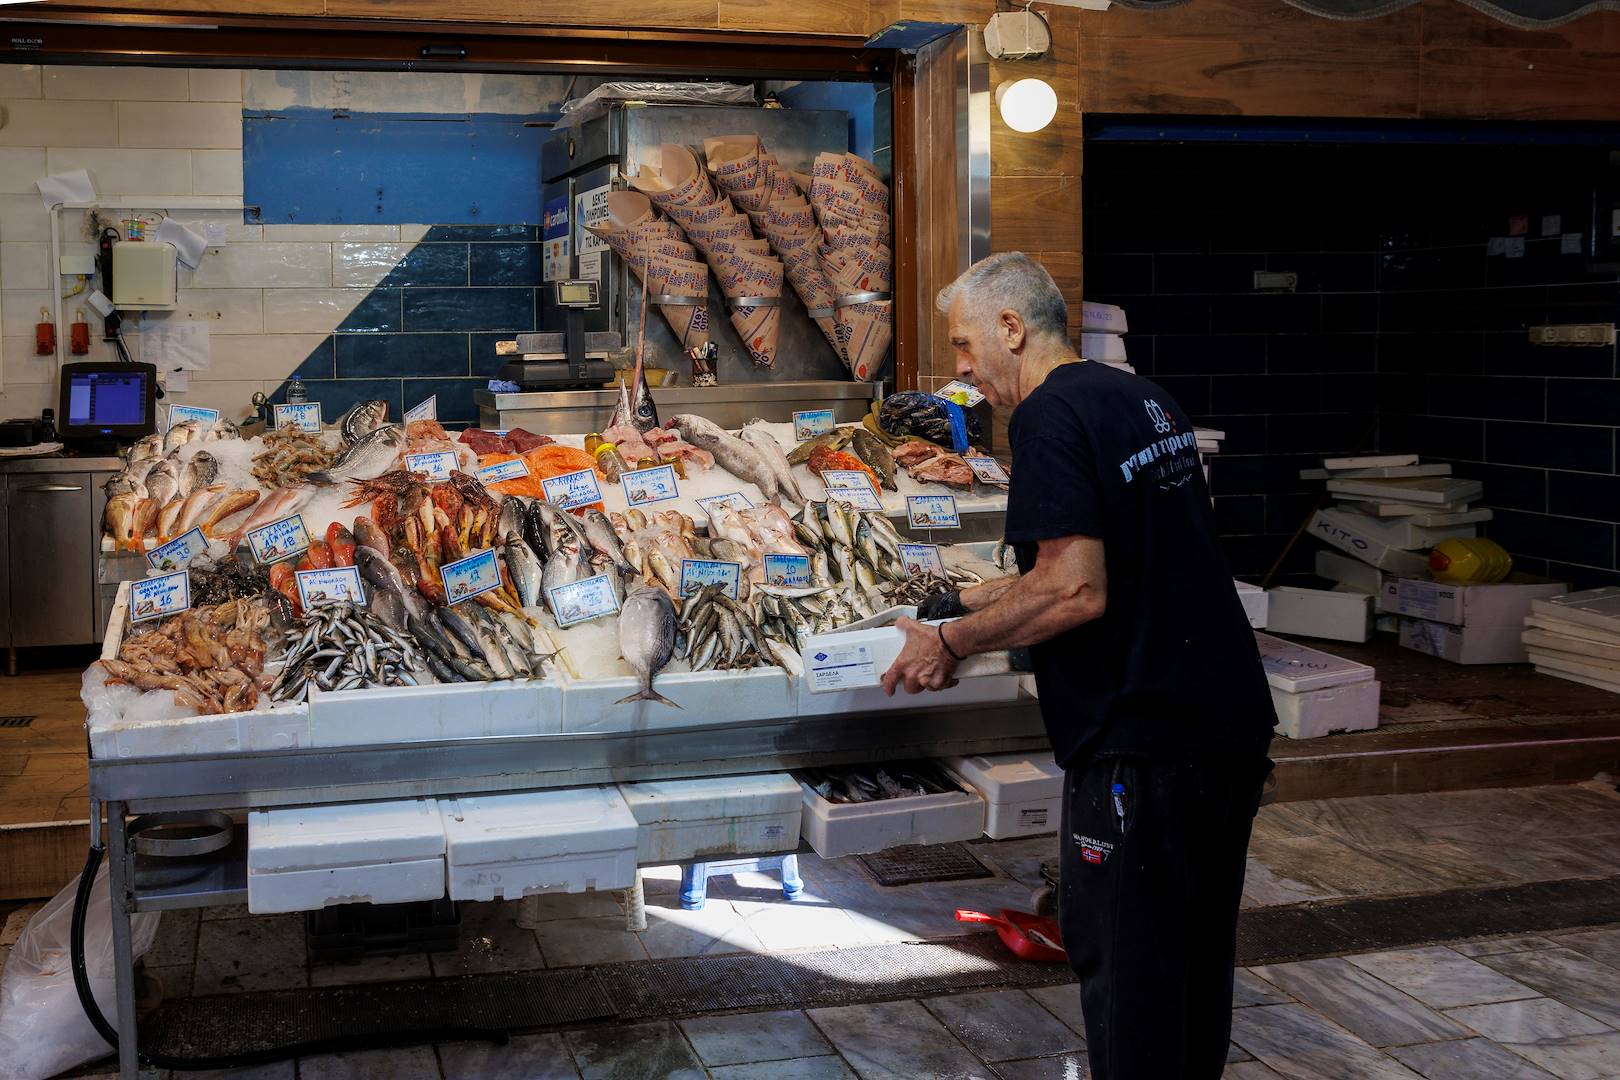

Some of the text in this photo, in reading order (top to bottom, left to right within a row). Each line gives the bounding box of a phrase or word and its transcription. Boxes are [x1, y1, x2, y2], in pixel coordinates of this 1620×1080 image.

[1317, 521, 1368, 550] KITO
[282, 536, 295, 549] 18
[785, 564, 796, 575] 10
[334, 584, 347, 595] 10
